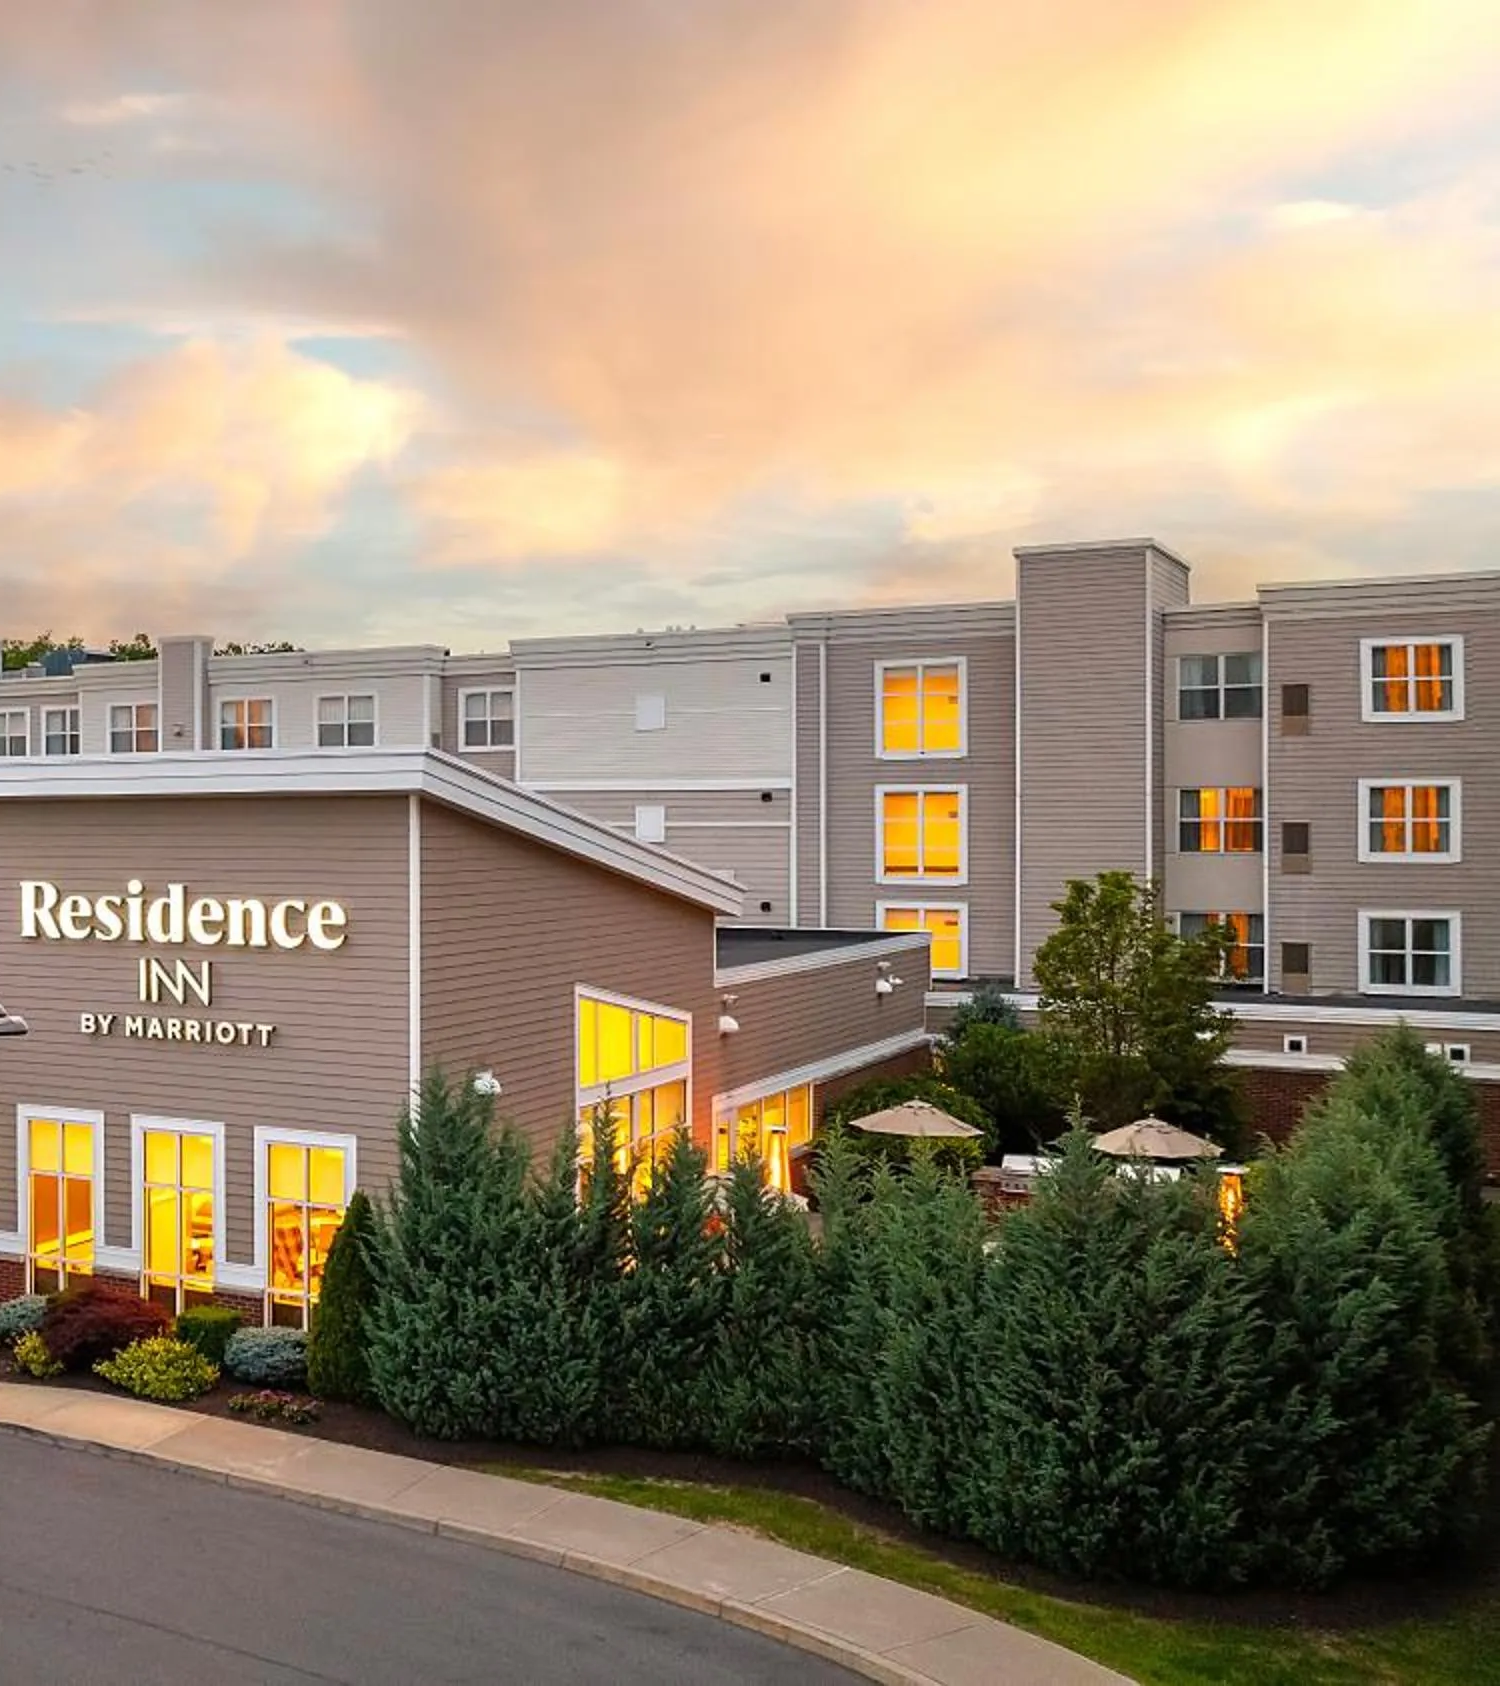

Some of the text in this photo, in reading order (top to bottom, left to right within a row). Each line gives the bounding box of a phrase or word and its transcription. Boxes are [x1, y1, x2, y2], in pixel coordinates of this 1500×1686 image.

[19, 879, 347, 950] Residence
[138, 957, 212, 1006] INN
[80, 1012, 275, 1047] BY MARRIOTT
